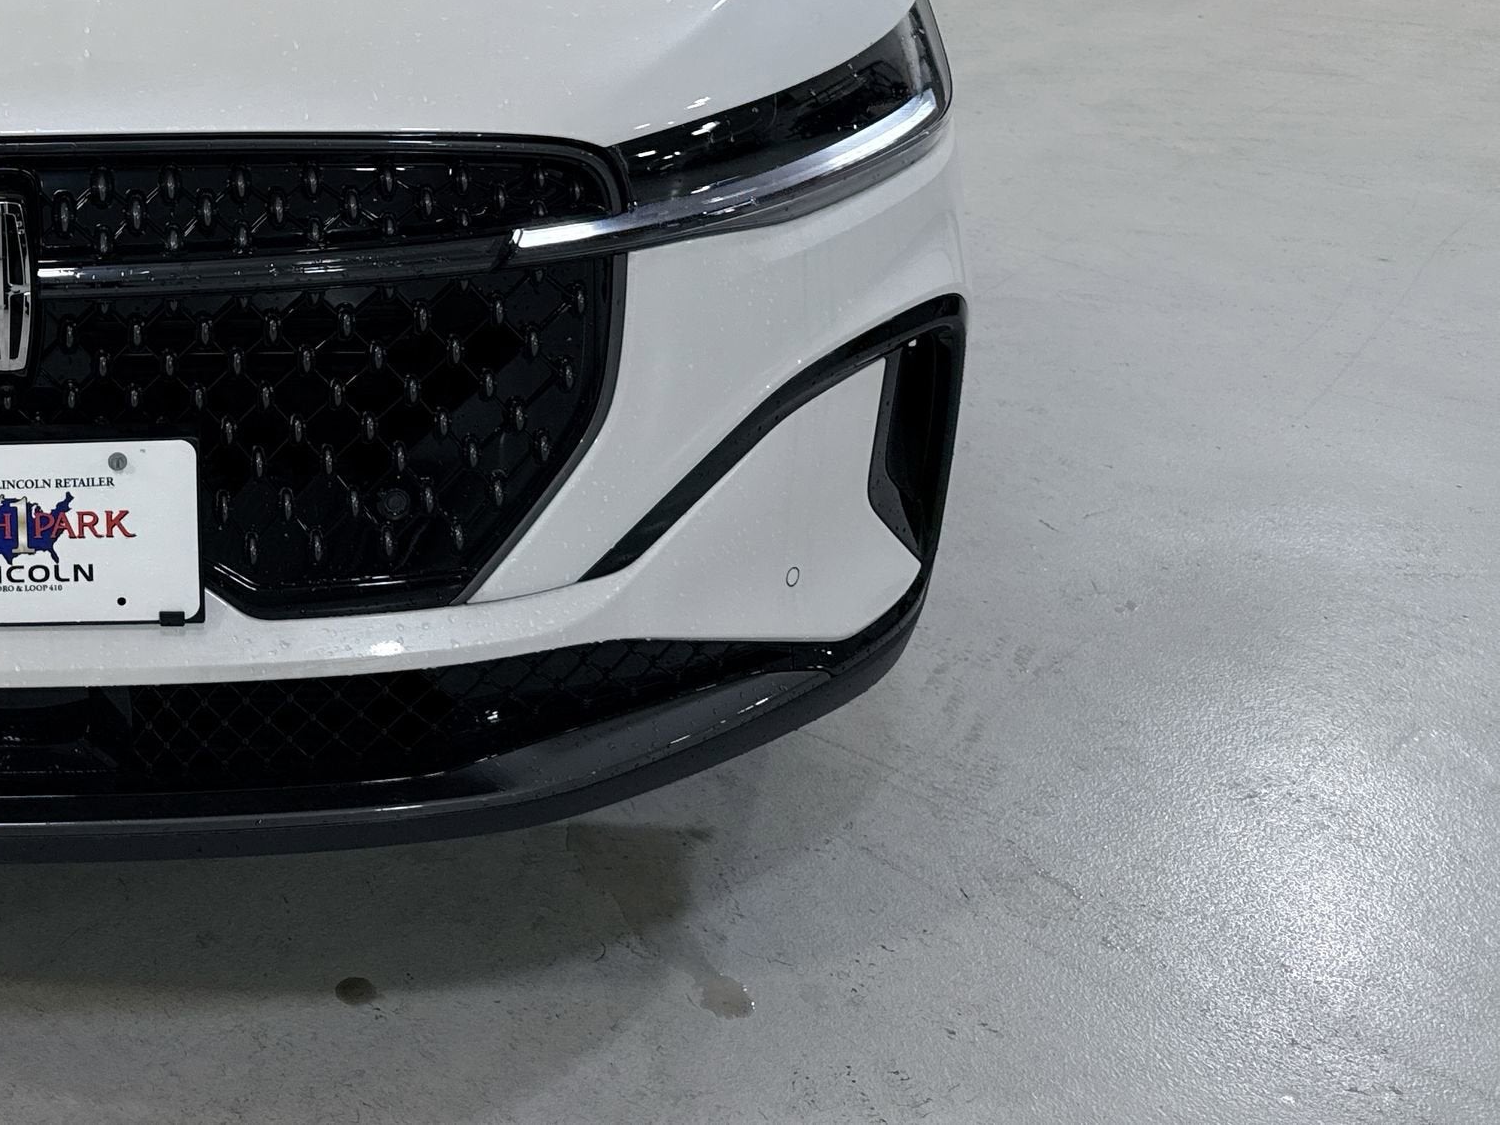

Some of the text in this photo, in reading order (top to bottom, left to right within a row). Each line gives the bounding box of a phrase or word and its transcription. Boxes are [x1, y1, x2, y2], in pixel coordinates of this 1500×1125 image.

[54, 476, 115, 488] RETAILER
[33, 509, 137, 540] PARK
[25, 584, 48, 592] LOOP
